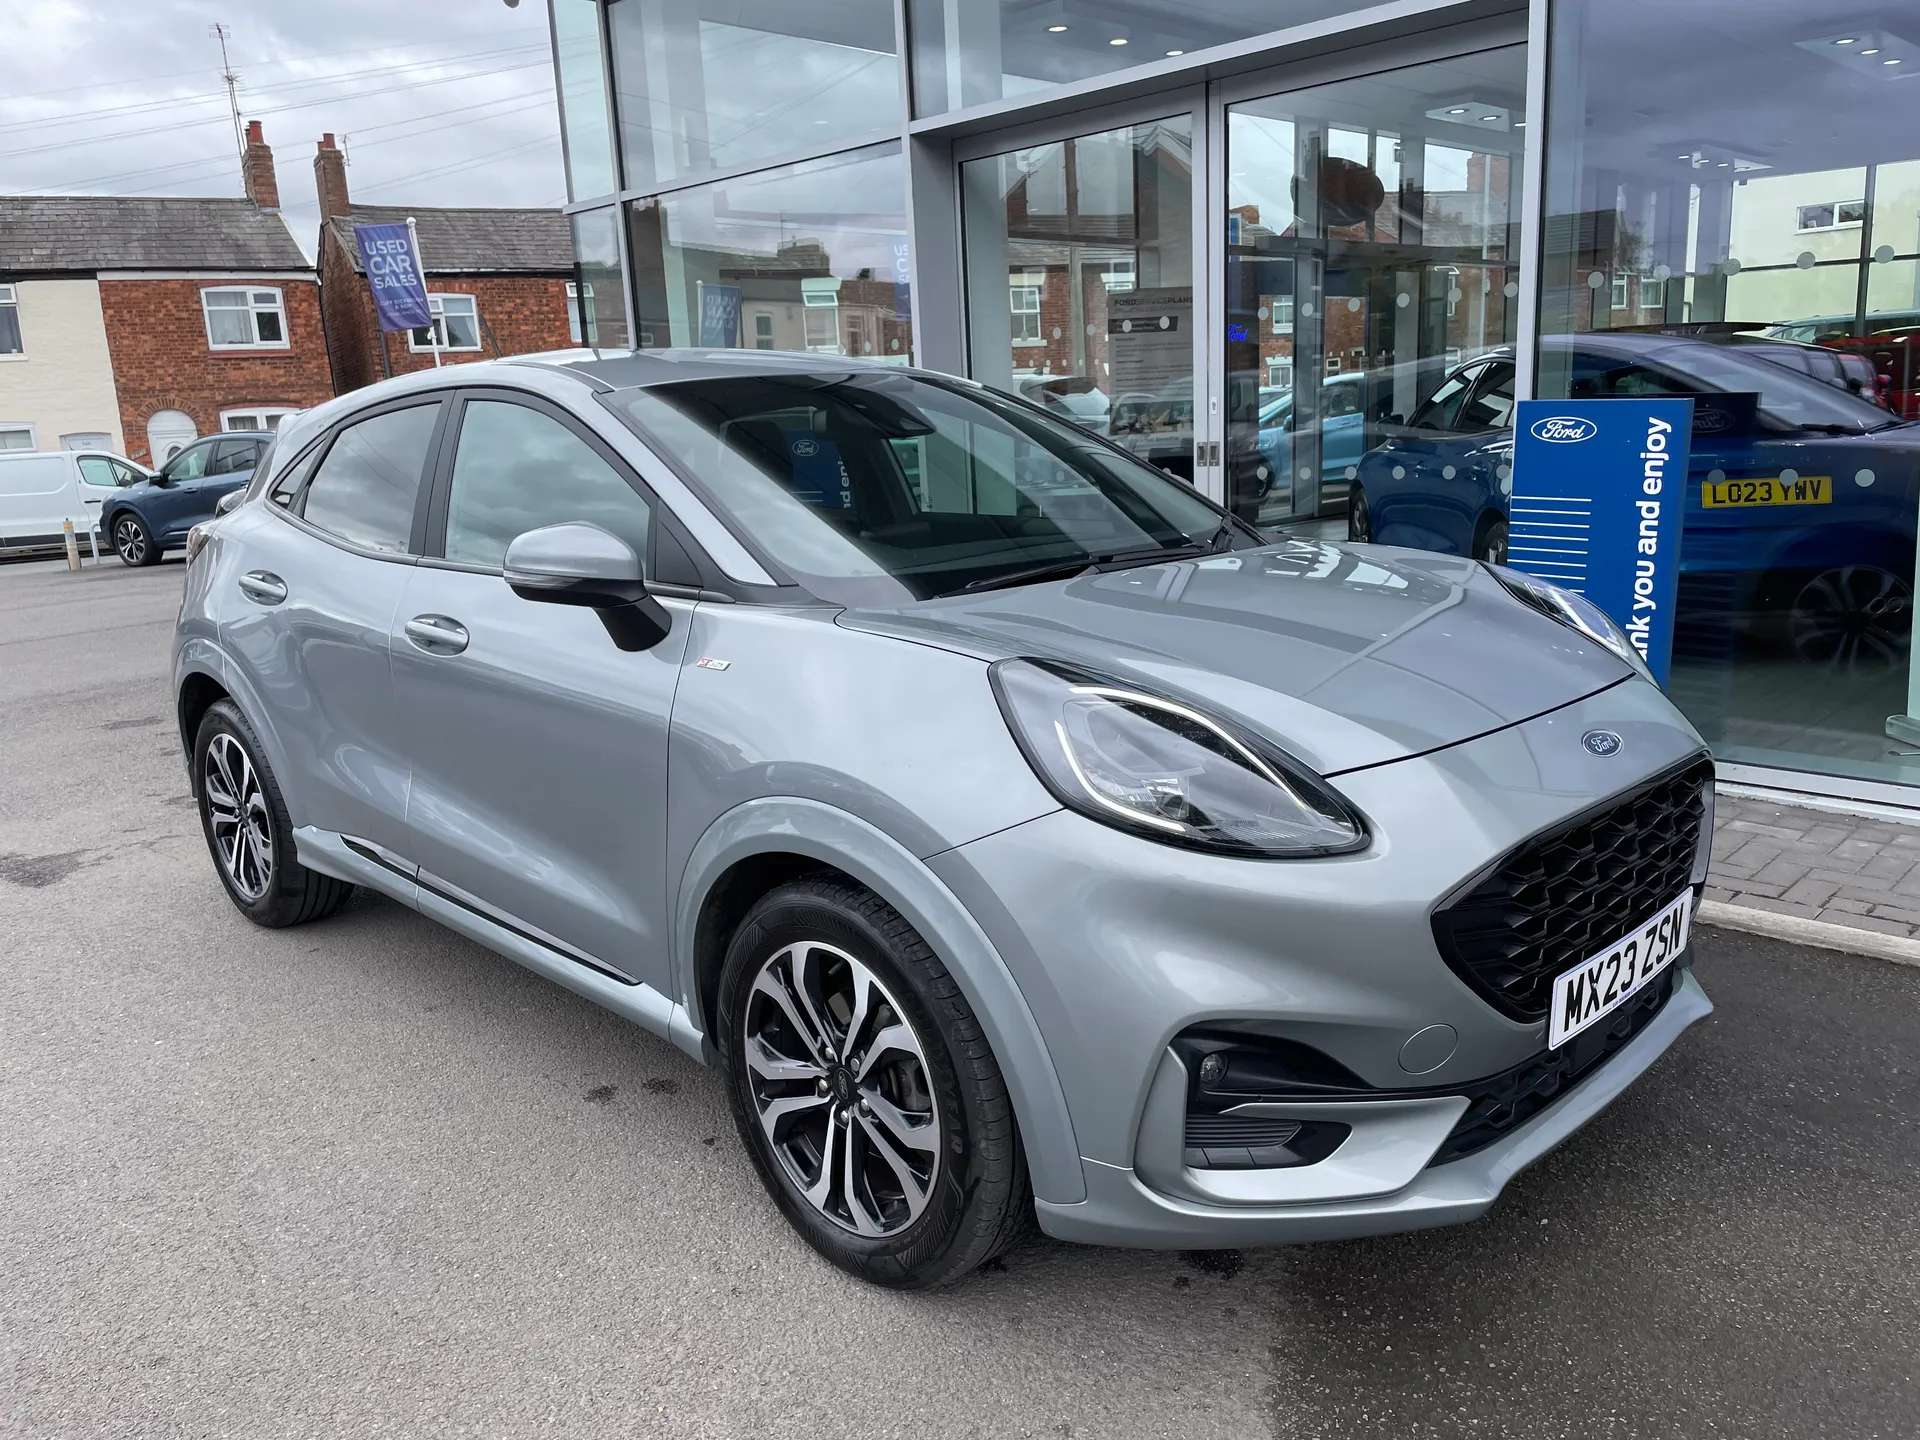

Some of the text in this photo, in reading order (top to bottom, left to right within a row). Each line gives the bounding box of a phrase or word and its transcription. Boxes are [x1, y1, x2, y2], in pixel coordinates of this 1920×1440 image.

[364, 239, 407, 255] USED
[369, 255, 412, 274] CAR
[374, 274, 417, 289] SALES
[1541, 420, 1585, 439] Ford
[1640, 416, 1672, 496] enjoy
[1711, 479, 1822, 504] LO23 YWV
[1635, 500, 1661, 555] and
[1633, 560, 1657, 610] you
[1563, 902, 1685, 1033] MX23 ZSN
